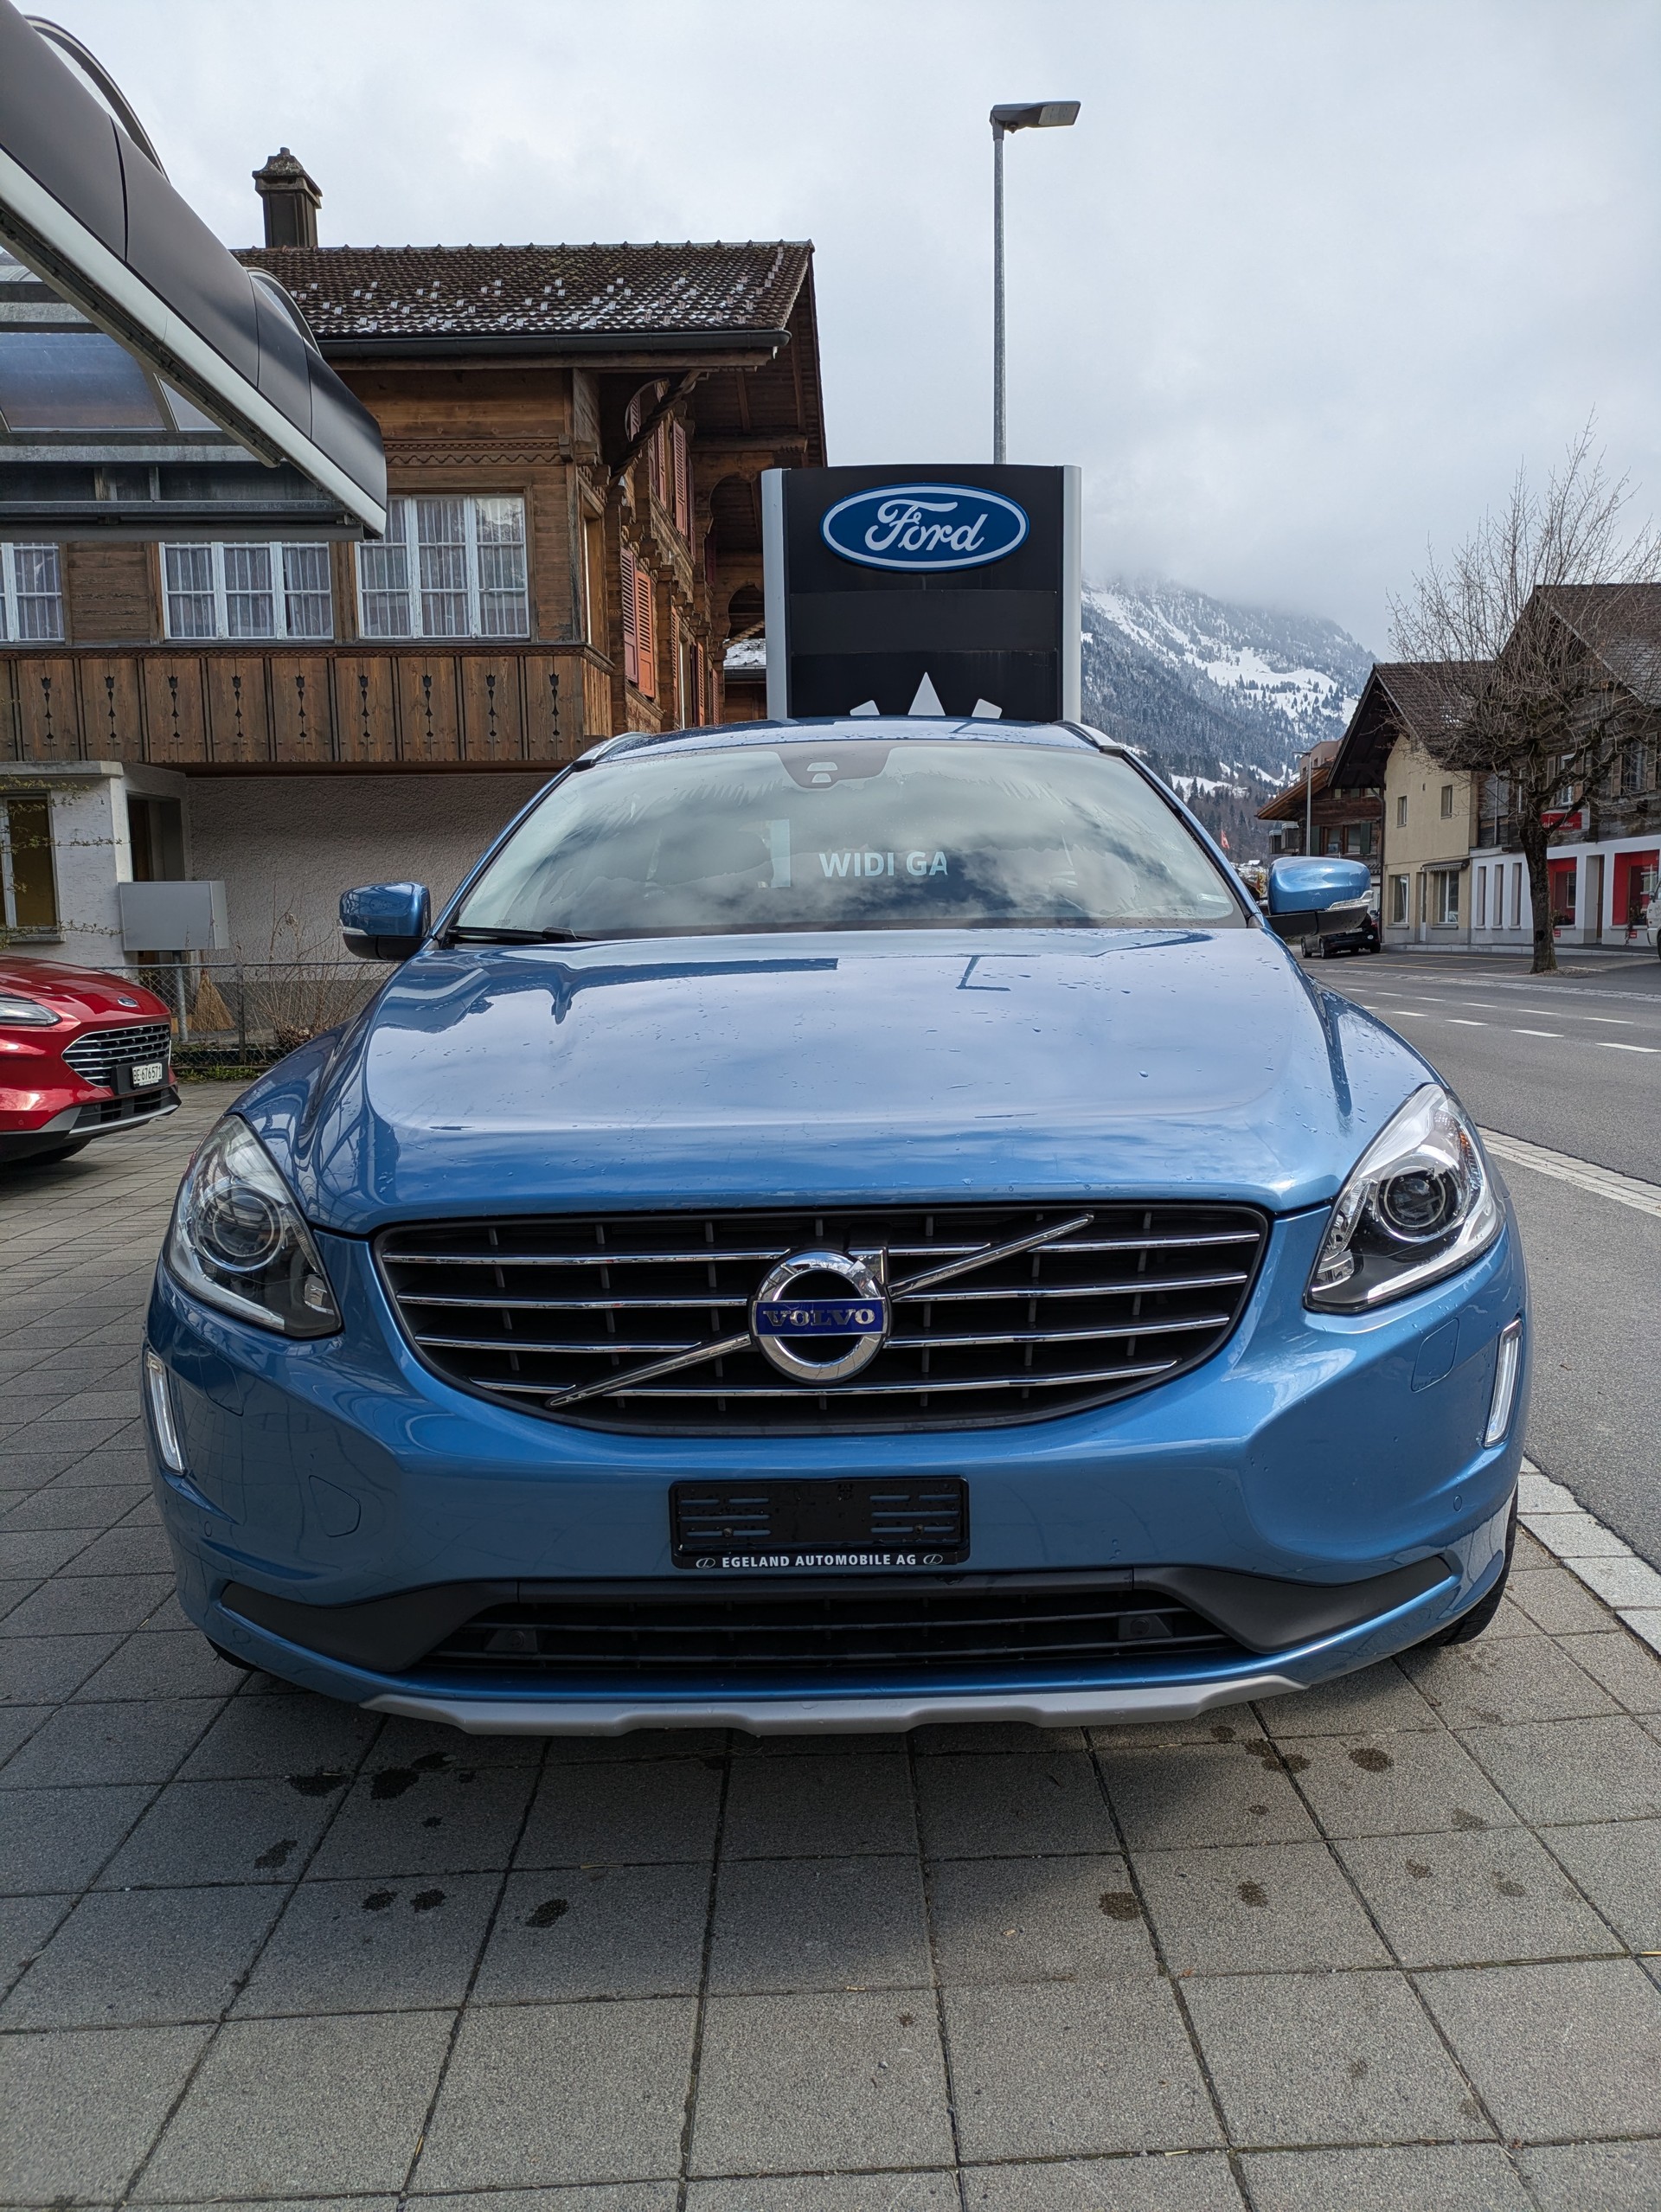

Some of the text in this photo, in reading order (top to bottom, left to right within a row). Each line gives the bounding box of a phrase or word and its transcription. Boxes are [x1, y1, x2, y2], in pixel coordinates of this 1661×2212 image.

[865, 499, 989, 551] Ford
[819, 852, 895, 877] WIDI
[762, 1308, 875, 1327] VOLVO
[721, 1554, 916, 1568] EGELAND AUTOMOBILE AG
